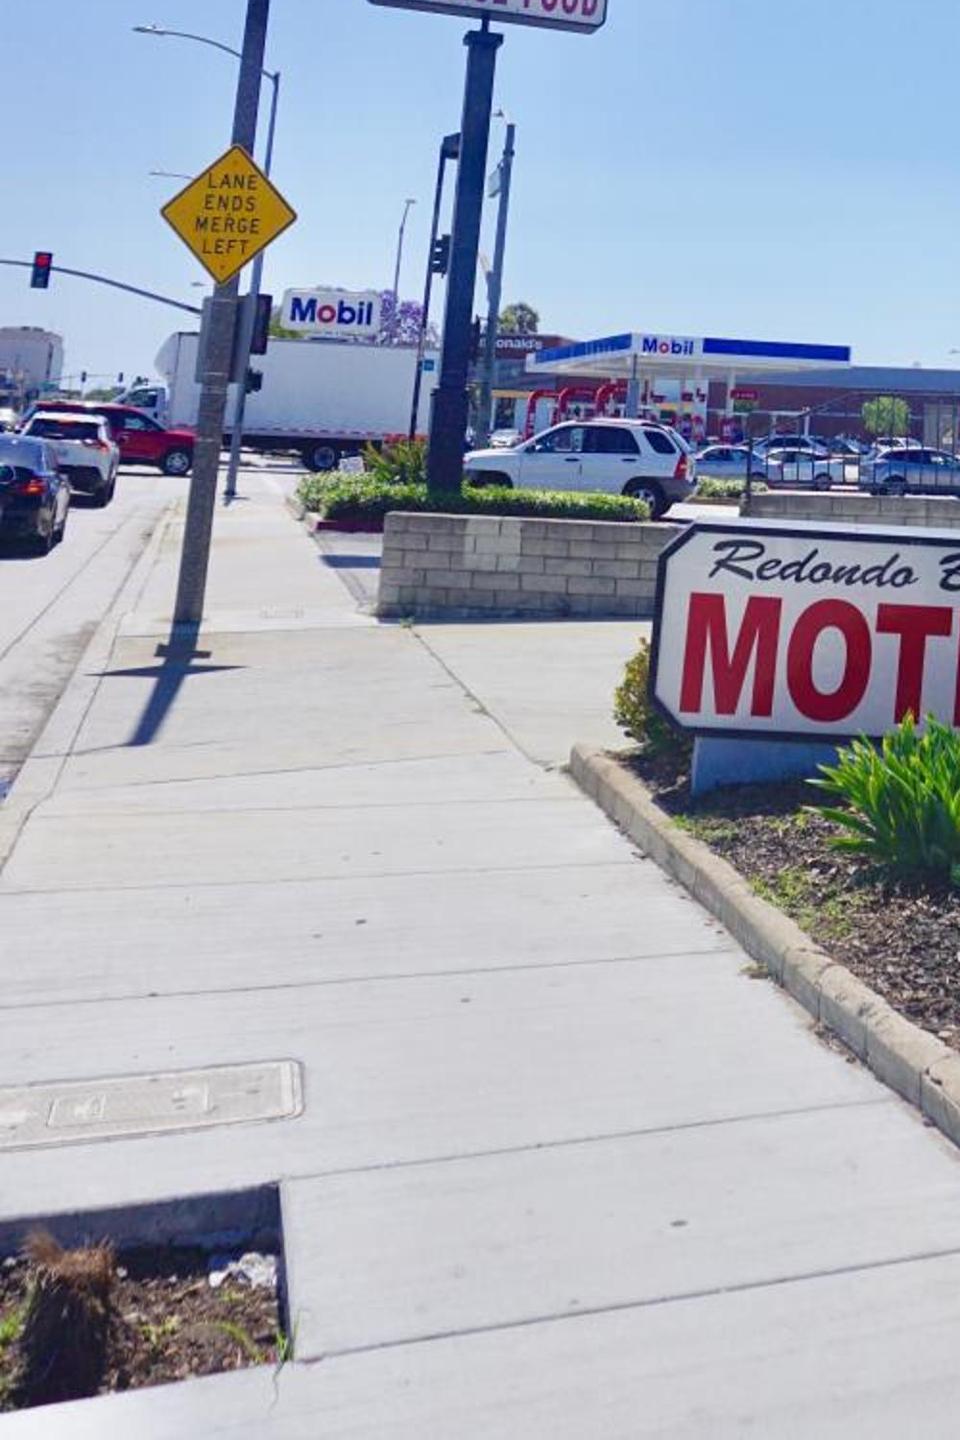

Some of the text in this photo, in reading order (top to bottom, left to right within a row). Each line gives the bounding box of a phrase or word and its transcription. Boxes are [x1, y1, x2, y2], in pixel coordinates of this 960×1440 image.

[207, 172, 258, 191] LANE
[204, 193, 257, 212] ENDS
[195, 216, 262, 235] MERGE
[202, 238, 249, 255] LEFT
[290, 296, 373, 326] Mobil
[642, 337, 694, 355] Mobil
[708, 539, 919, 588] Redondo
